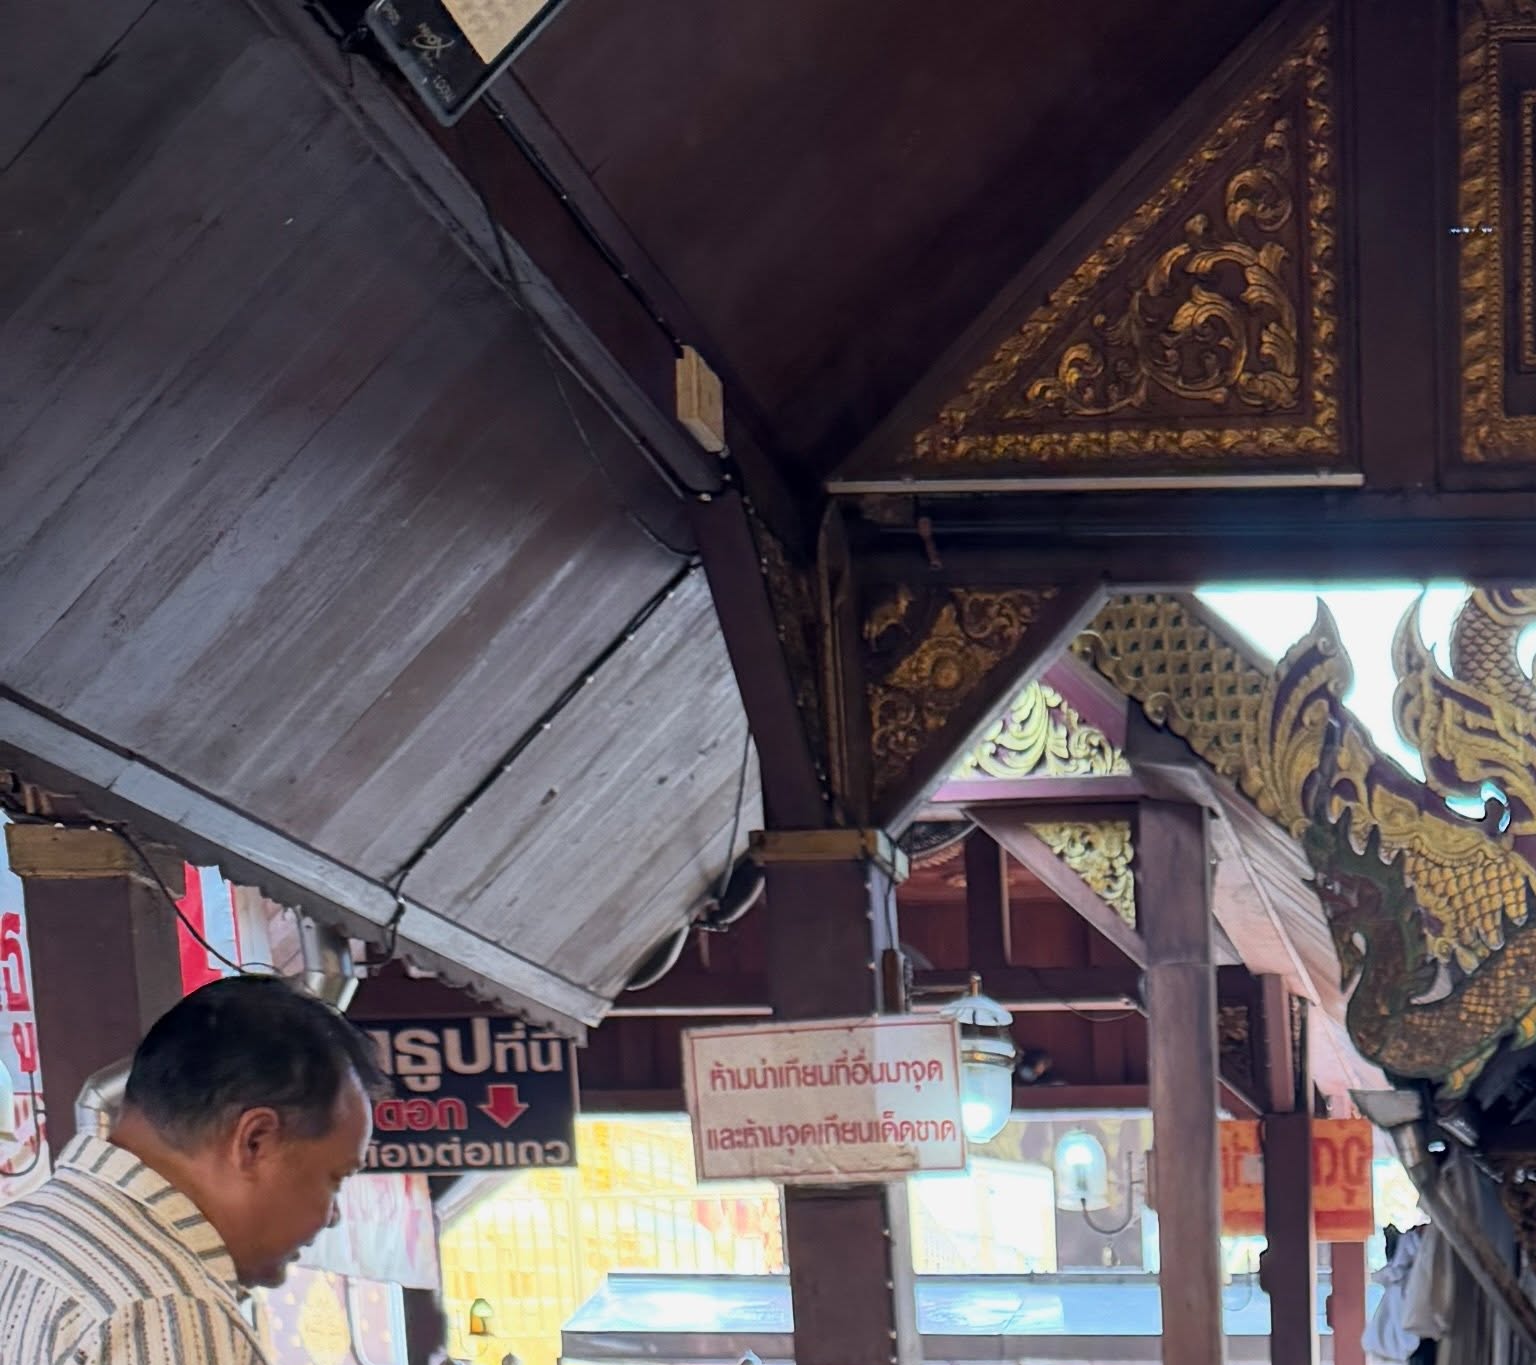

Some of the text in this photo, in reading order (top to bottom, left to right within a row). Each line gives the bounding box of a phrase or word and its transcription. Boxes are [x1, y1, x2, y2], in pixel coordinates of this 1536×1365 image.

[366, 1016, 564, 1093] ธูปที่นี
[707, 1110, 957, 1155] และห้ามจุดเทียนเด็ดขาด
